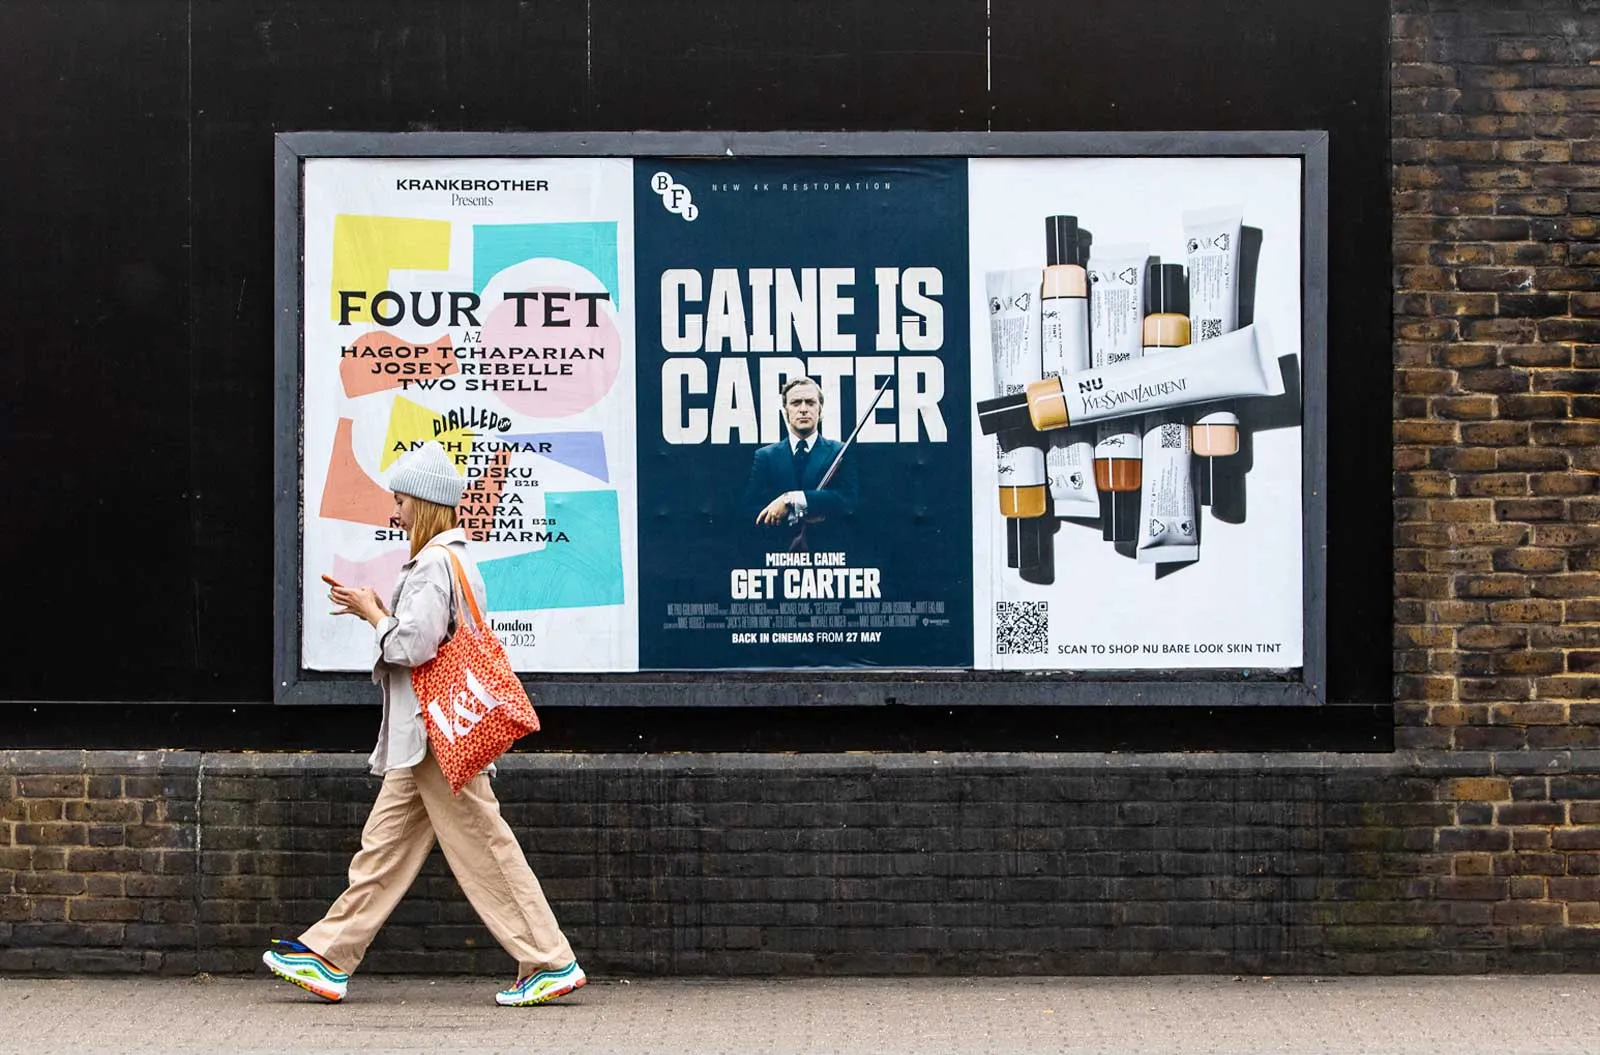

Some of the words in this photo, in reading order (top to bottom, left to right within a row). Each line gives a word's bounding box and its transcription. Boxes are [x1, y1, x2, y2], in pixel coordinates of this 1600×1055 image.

[396, 179, 549, 192] KRANKBROTHER
[712, 183, 740, 192] NEW
[753, 183, 770, 192] 4K
[782, 182, 890, 191] RESTORATION
[451, 193, 494, 207] Presents
[338, 290, 482, 327] FOUR
[503, 291, 610, 328] TET
[660, 267, 857, 353] CAINE
[874, 266, 945, 352] IS
[463, 331, 482, 343] A-Z
[340, 345, 429, 359] HAGOP
[436, 346, 605, 360] TCHAPARIAN
[371, 362, 453, 375] JOSEY
[461, 363, 573, 376] REBELLE
[397, 378, 456, 391] TWO
[465, 379, 548, 392] SHELL
[1078, 378, 1104, 394] NU
[661, 355, 948, 445] CARTER
[432, 405, 498, 437] DIALLED
[393, 440, 462, 453] ANH
[471, 441, 552, 453] KUMAR
[454, 454, 507, 466] RTHI
[467, 467, 533, 479] DISKU
[493, 480, 508, 491] T
[532, 518, 557, 526] B2B
[471, 530, 570, 543] SHARMA
[765, 552, 813, 567] MICHAEL
[813, 552, 846, 567] CAINE
[730, 568, 779, 600] GET
[783, 567, 882, 599] CARTER
[491, 618, 533, 632] London
[510, 632, 536, 647] 2022
[731, 632, 758, 644] BACK
[759, 632, 770, 644] IN
[771, 632, 814, 644] CINEMAS
[816, 631, 844, 643] FROM
[845, 632, 858, 643] 27
[860, 631, 882, 643] MAY
[1058, 645, 1087, 654] SCAN
[1091, 644, 1106, 654] TO
[1108, 644, 1140, 654] SHOP
[1142, 644, 1159, 654] NU
[1162, 644, 1190, 654] BARE
[1194, 644, 1223, 653] LOOK
[1227, 643, 1253, 653] SKIN
[1257, 643, 1281, 653] TINT
